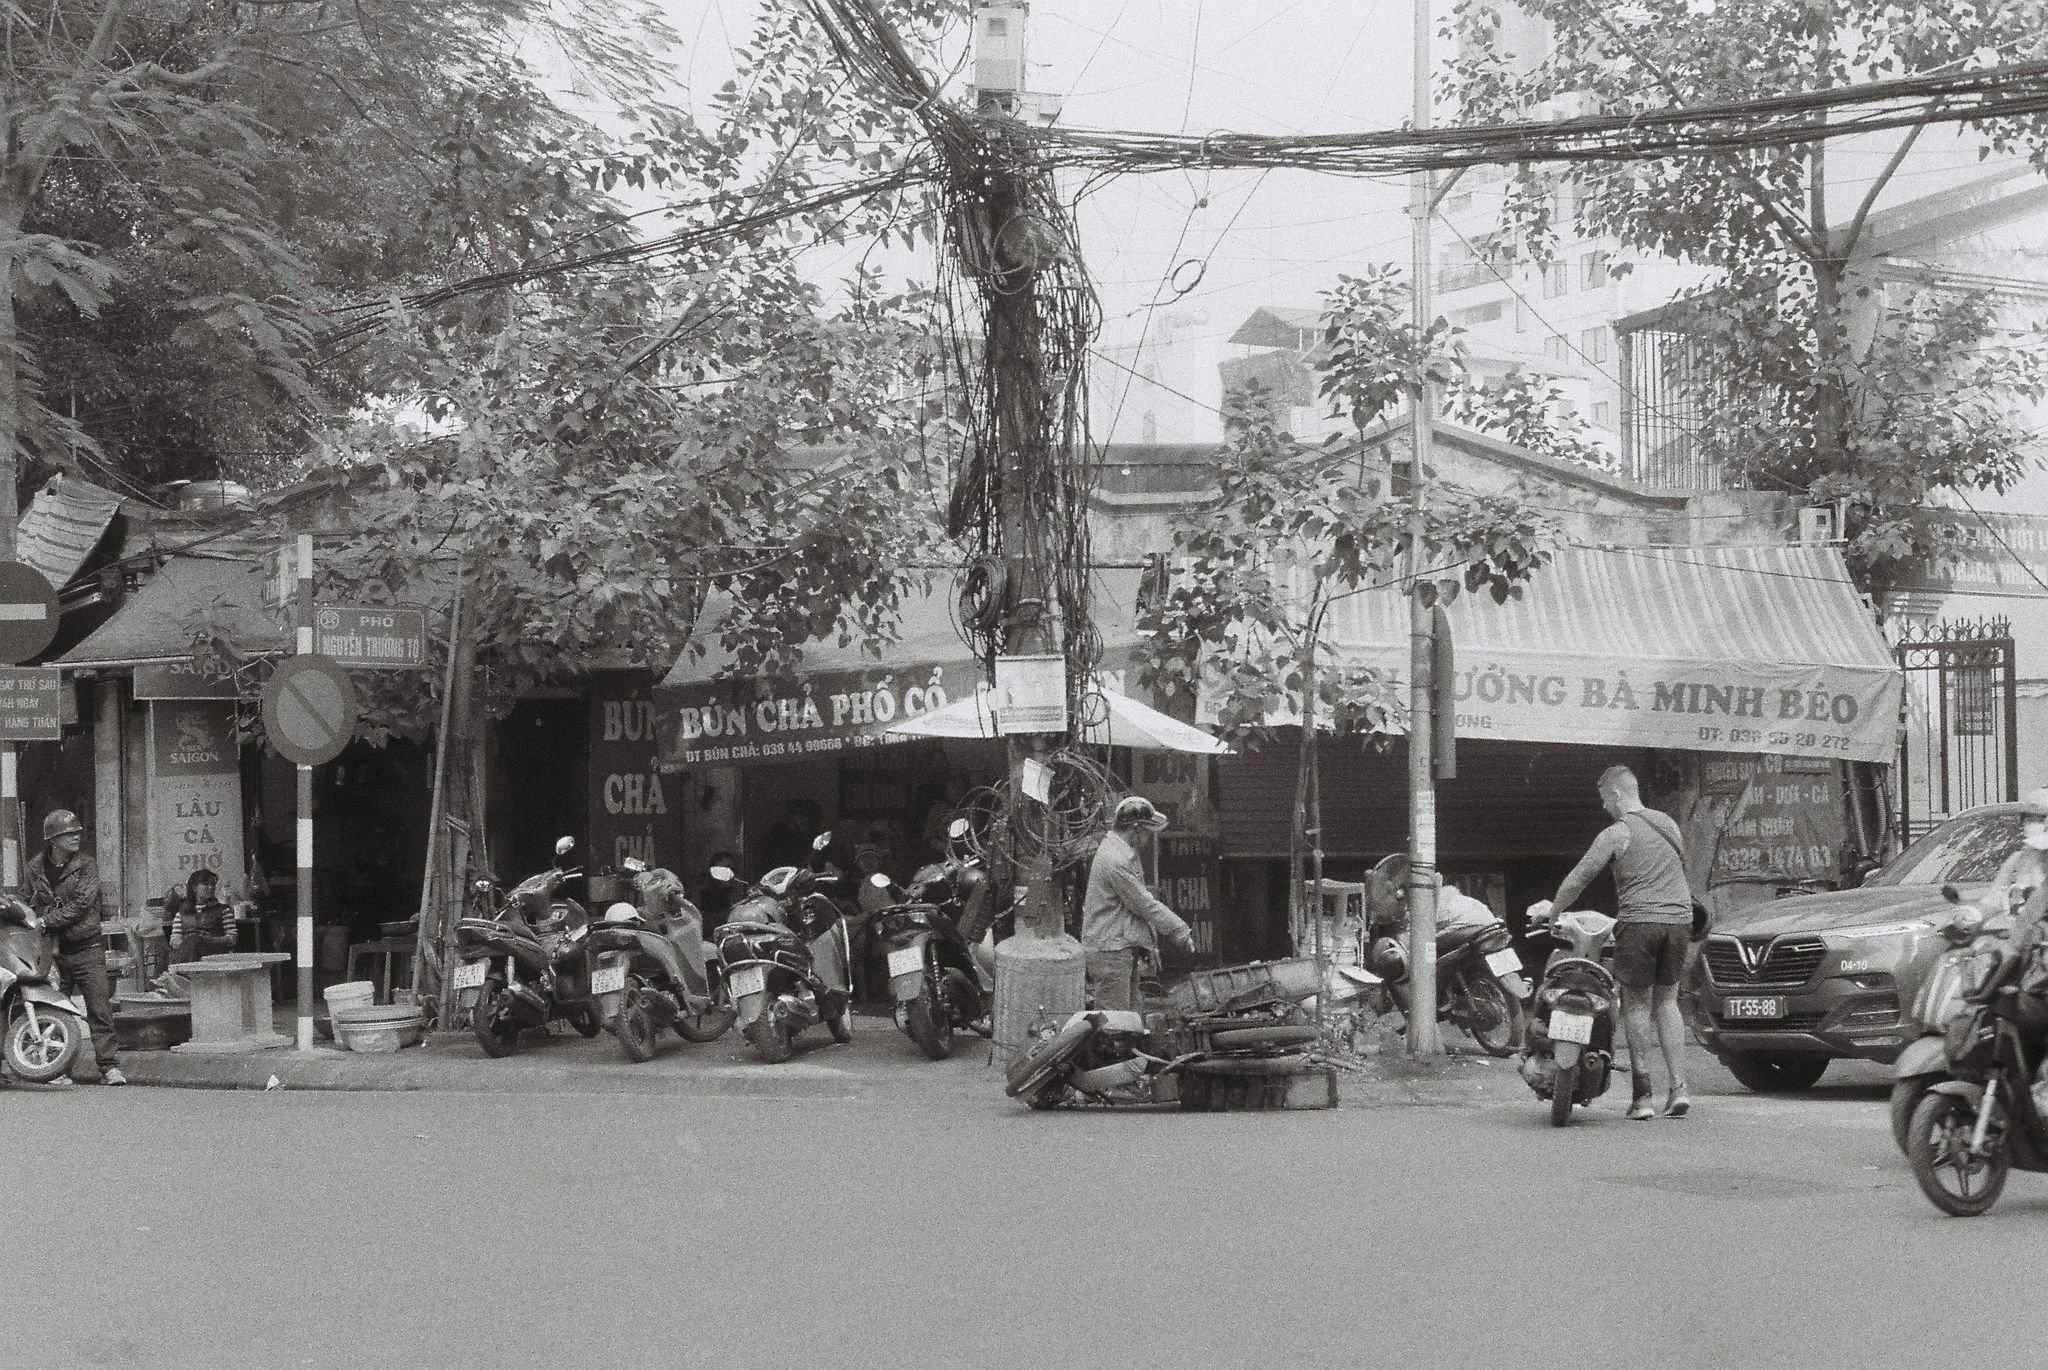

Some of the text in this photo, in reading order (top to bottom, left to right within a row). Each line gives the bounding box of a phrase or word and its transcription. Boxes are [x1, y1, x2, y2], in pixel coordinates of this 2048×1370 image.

[360, 612, 395, 628] PHỐ
[680, 696, 747, 739] BÚN
[755, 683, 824, 732] CHẢ
[1580, 670, 1639, 711] BÀ
[1651, 680, 1765, 718] MINH
[1777, 681, 1859, 725] BÉO
[170, 752, 219, 763] SAIGON
[603, 756, 668, 815] CHẢ
[1841, 960, 1867, 971] 04-10
